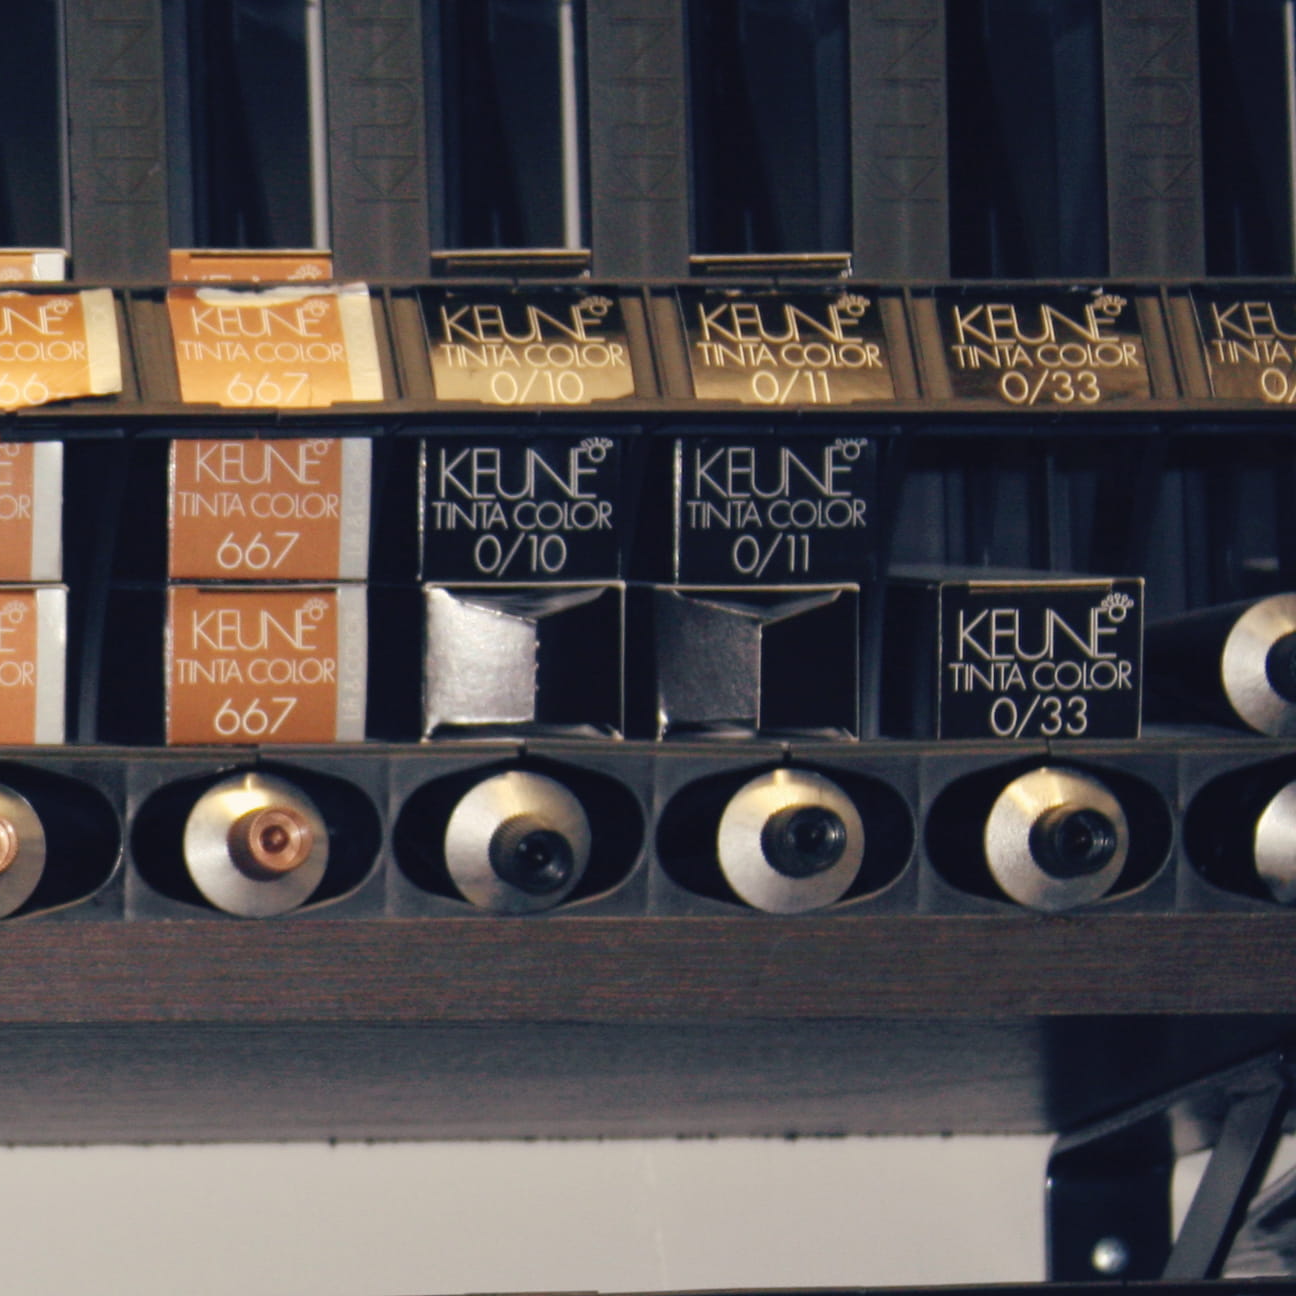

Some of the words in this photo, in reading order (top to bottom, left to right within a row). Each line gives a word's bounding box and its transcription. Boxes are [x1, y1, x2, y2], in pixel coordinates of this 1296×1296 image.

[441, 303, 606, 341] KEUNE
[954, 304, 1119, 343] KEUNE
[439, 343, 522, 367] TINTA
[524, 343, 624, 367] COLOR
[953, 345, 1034, 368] TINTA
[1036, 343, 1138, 368] COLOR
[491, 371, 584, 404] 0/10
[1003, 373, 1100, 404] 0/33
[194, 444, 320, 484] KEUNE
[441, 448, 599, 498] KEUNE
[695, 448, 852, 498] KEUNE
[178, 492, 249, 517] TINTA
[250, 492, 338, 518] COLOR
[432, 502, 512, 530] TINTA
[513, 501, 612, 530] COLOR
[687, 500, 769, 529] TINTA
[770, 500, 866, 529] COLOR
[216, 532, 299, 569] 667
[475, 536, 568, 577] 0/10
[734, 536, 810, 574] 0/11
[957, 609, 1117, 661] KEUNE
[949, 664, 1029, 692] TINTA
[1032, 663, 1133, 690] COLOR
[991, 699, 1088, 737] 0/33
